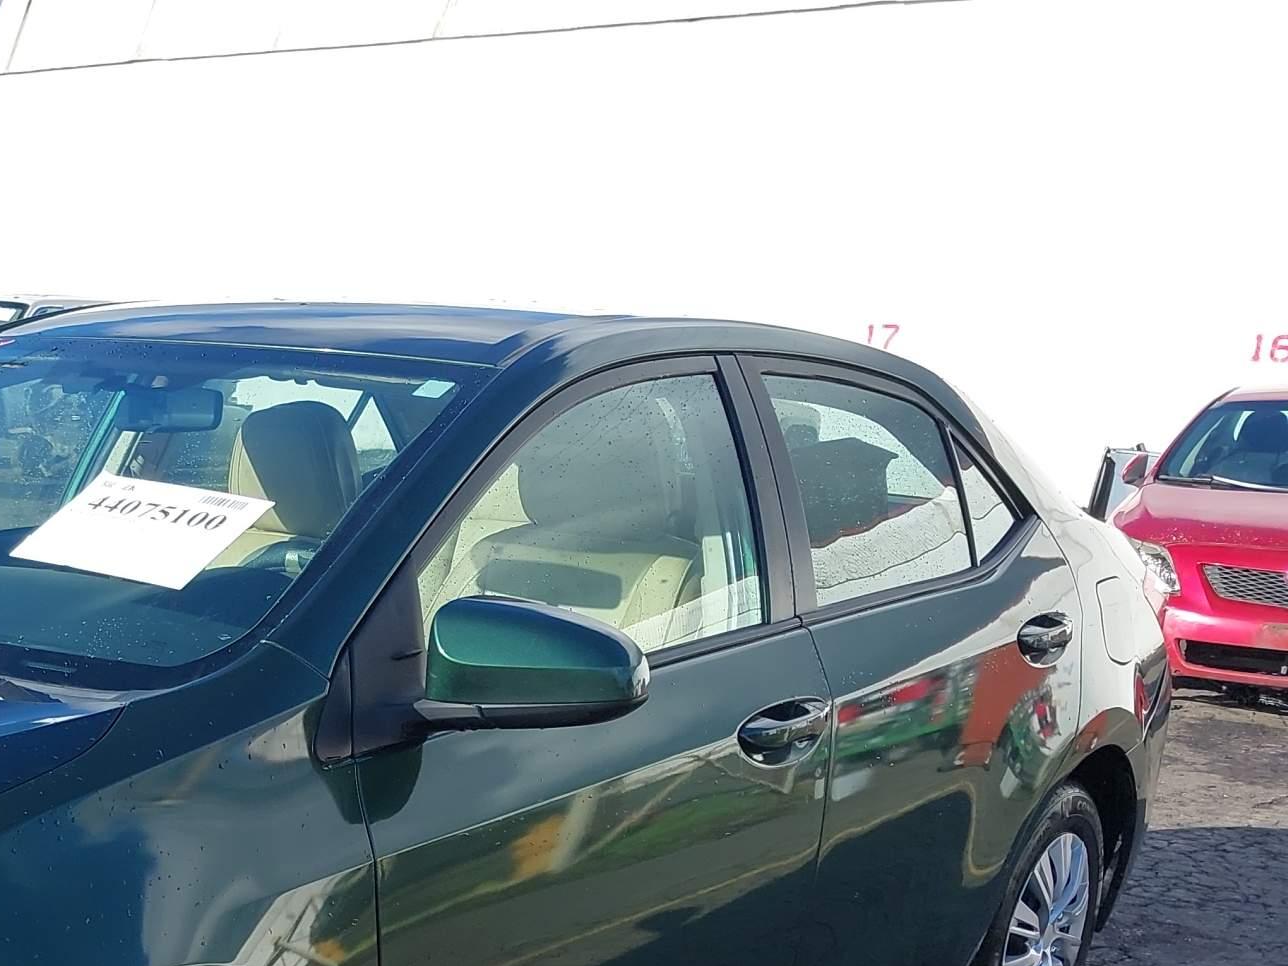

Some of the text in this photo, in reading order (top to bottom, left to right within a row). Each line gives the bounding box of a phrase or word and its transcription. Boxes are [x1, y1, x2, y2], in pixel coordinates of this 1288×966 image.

[868, 324, 900, 350] 17
[1250, 333, 1288, 362] 16
[88, 496, 228, 531] 44075100
